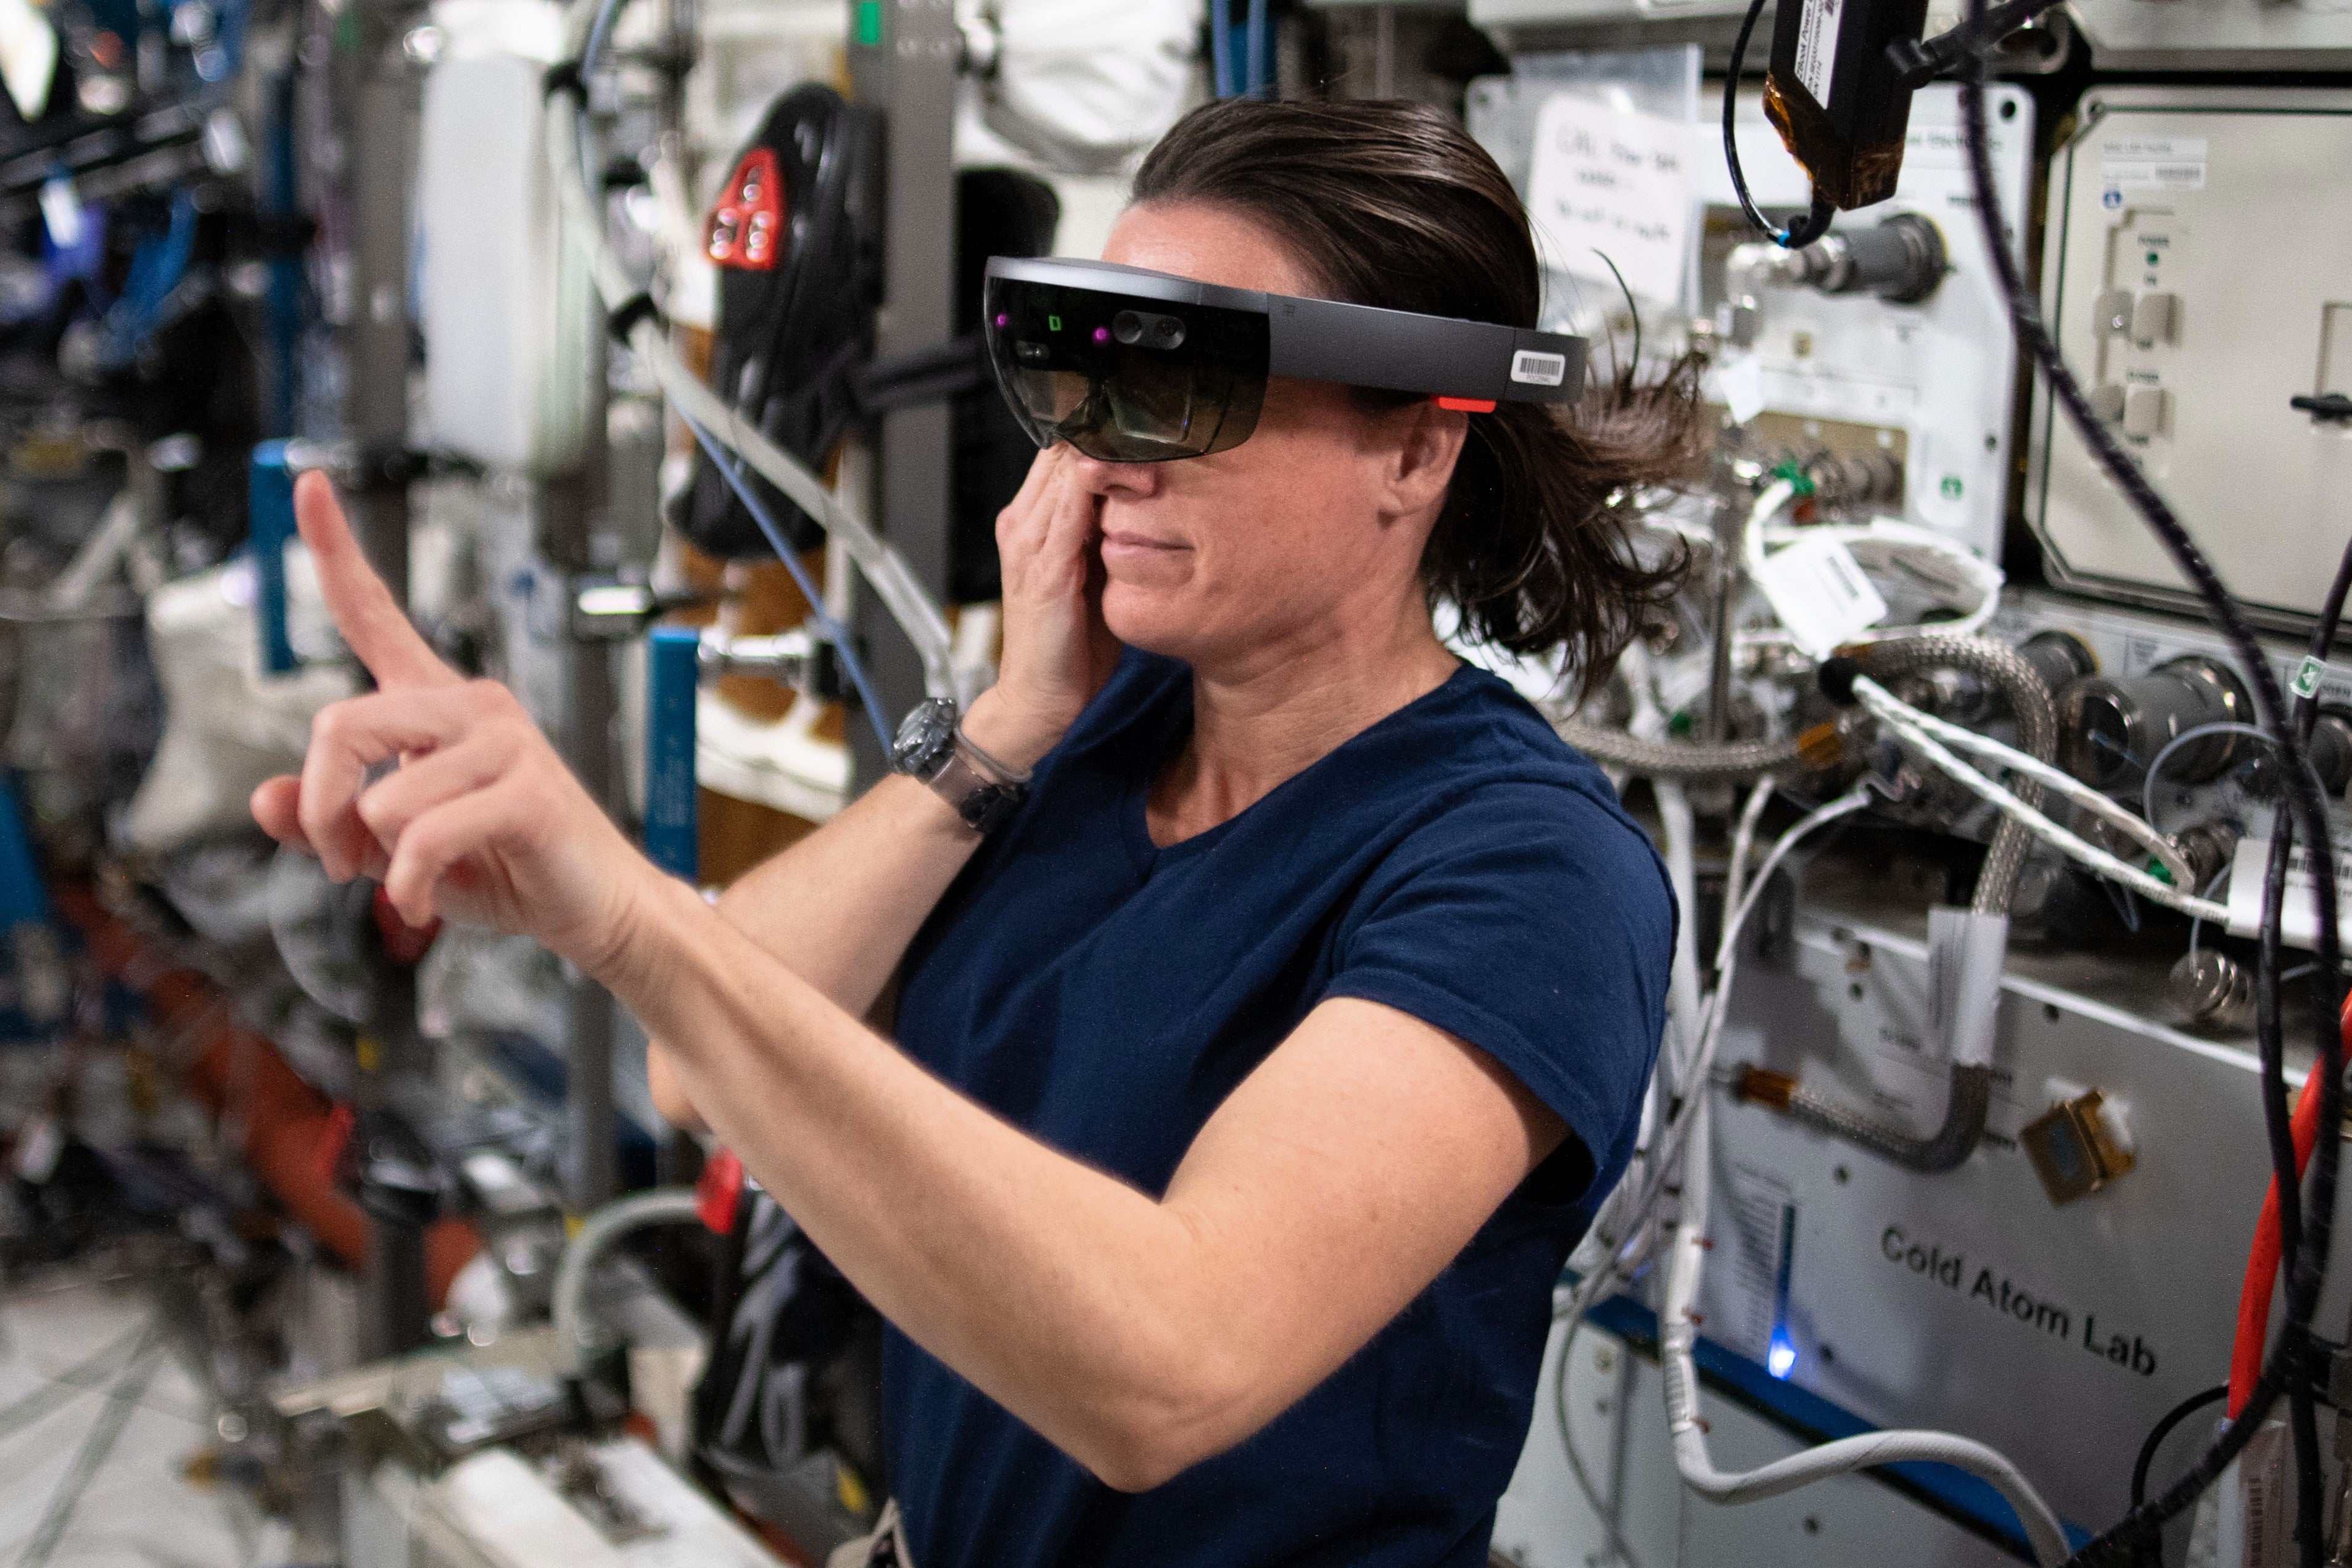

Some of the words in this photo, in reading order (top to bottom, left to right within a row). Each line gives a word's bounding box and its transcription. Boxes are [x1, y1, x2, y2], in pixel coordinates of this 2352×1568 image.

[1802, 5, 1810, 41] Power
[1882, 1226, 1960, 1288] Cold
[1971, 1268, 2069, 1339] Atom
[2082, 1315, 2155, 1376] Lab
